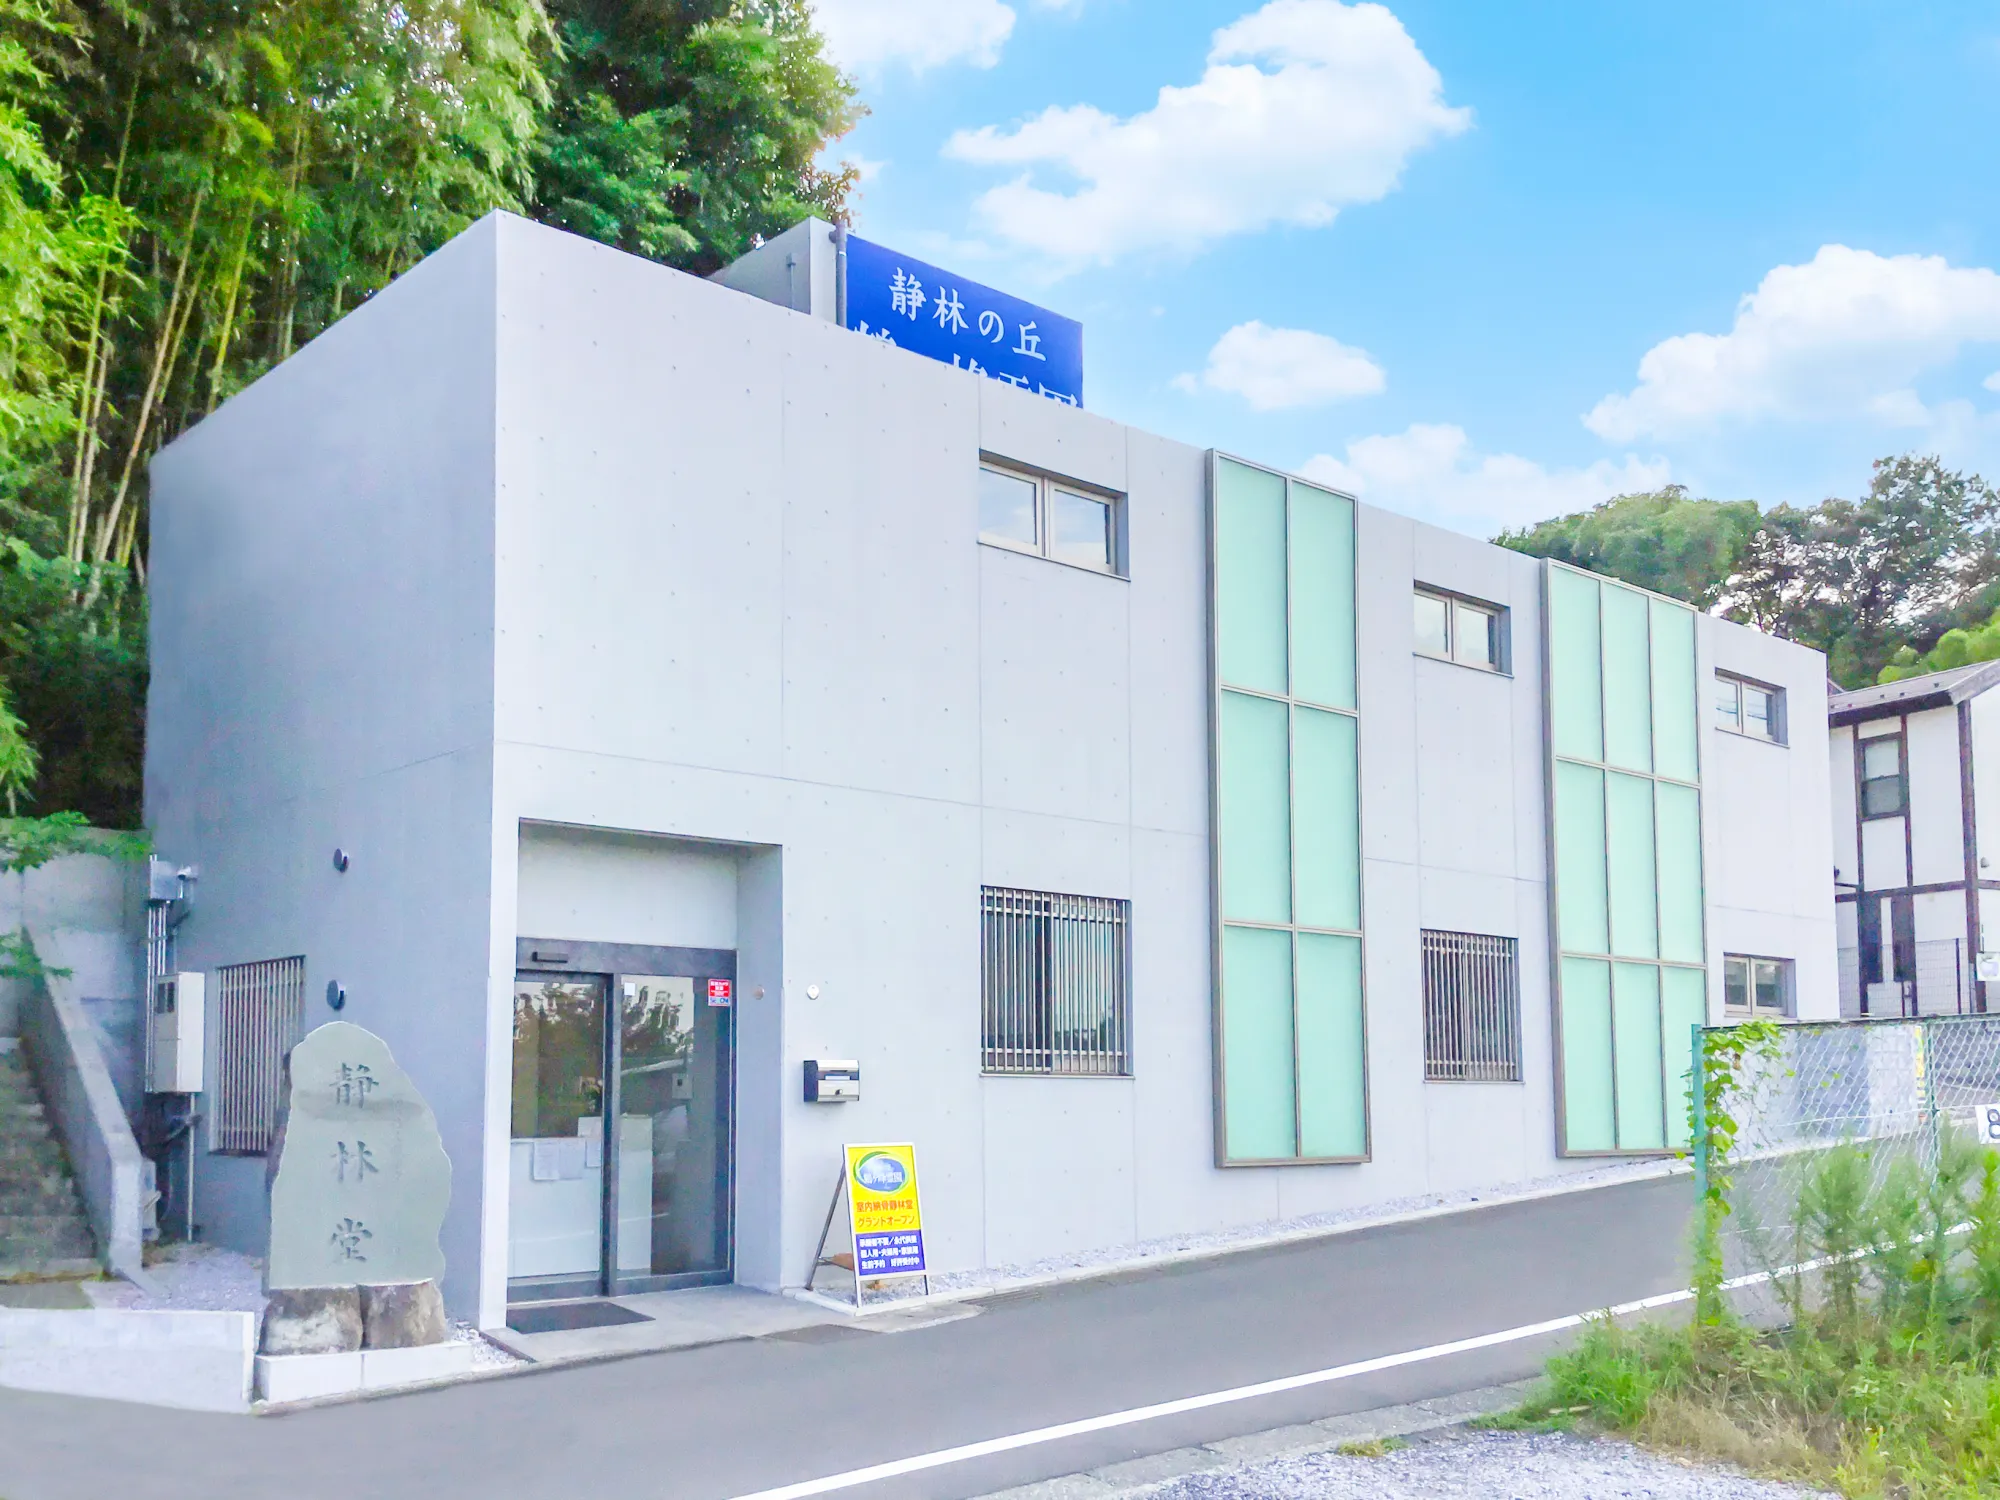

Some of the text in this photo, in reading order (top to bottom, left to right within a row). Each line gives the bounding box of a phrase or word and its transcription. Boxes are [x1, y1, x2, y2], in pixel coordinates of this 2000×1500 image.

[888, 267, 1047, 361] 静林の丘
[329, 1062, 379, 1263] 静林堂
